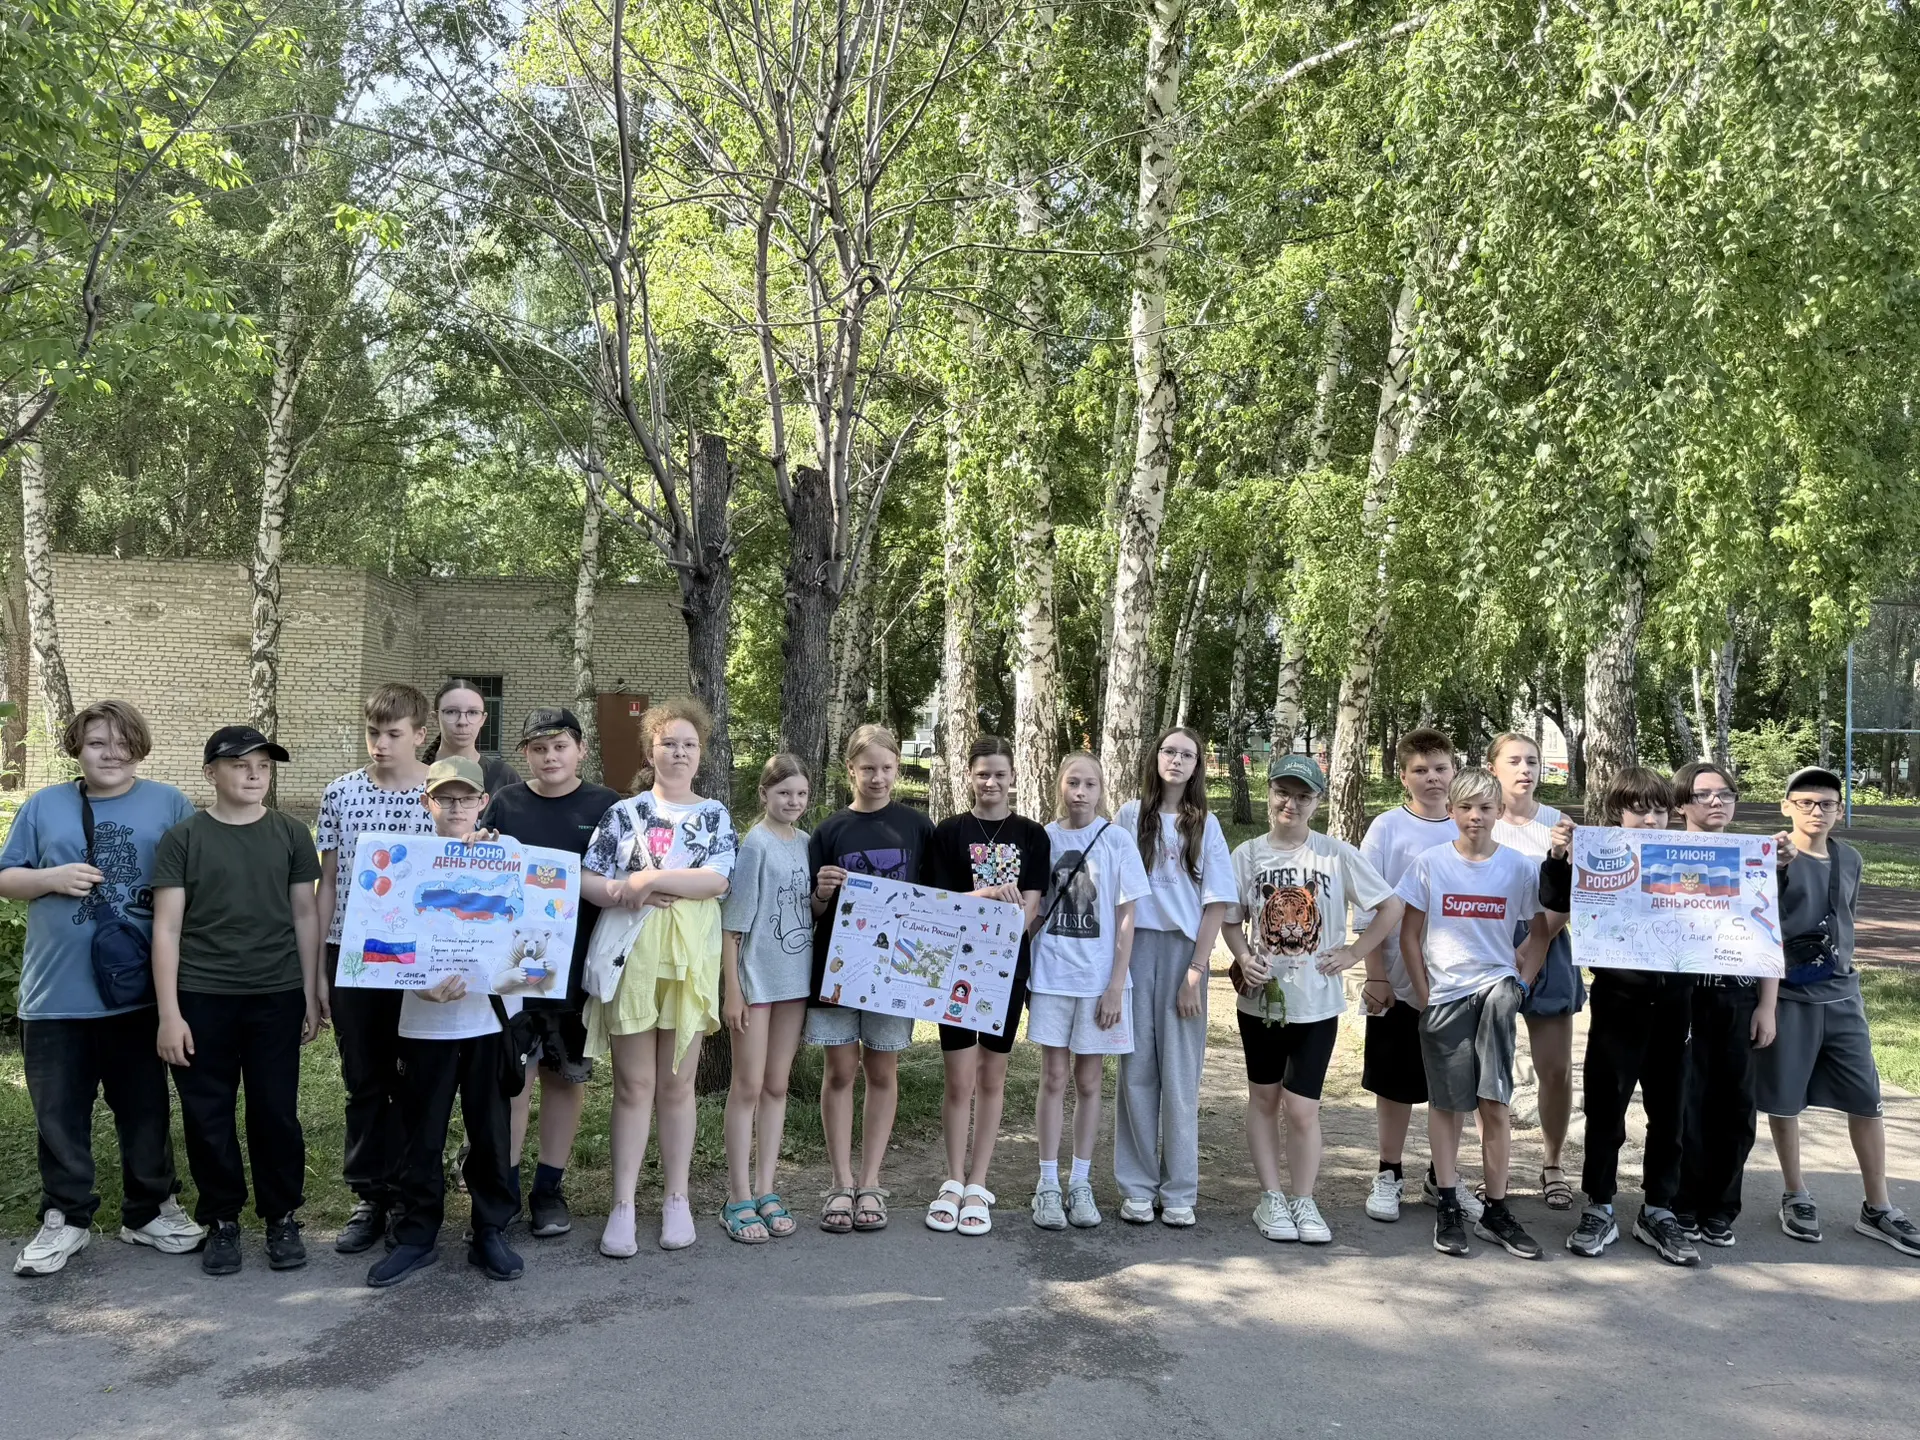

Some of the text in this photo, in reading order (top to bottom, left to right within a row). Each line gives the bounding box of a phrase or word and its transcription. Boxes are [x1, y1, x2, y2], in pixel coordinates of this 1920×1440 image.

[447, 844, 504, 859] 12 ИЮНЯ
[1666, 849, 1716, 861] 12 ИЮНЯ
[433, 856, 521, 872] ДЕНЬ РОССИИ
[1596, 859, 1626, 870] ДЕНЬ
[1586, 870, 1635, 888] РОССИИ
[1444, 896, 1505, 915] Supreme
[1651, 898, 1730, 910] ДЕНЬ РОССИИ
[902, 920, 908, 928] С
[931, 926, 959, 939] России!
